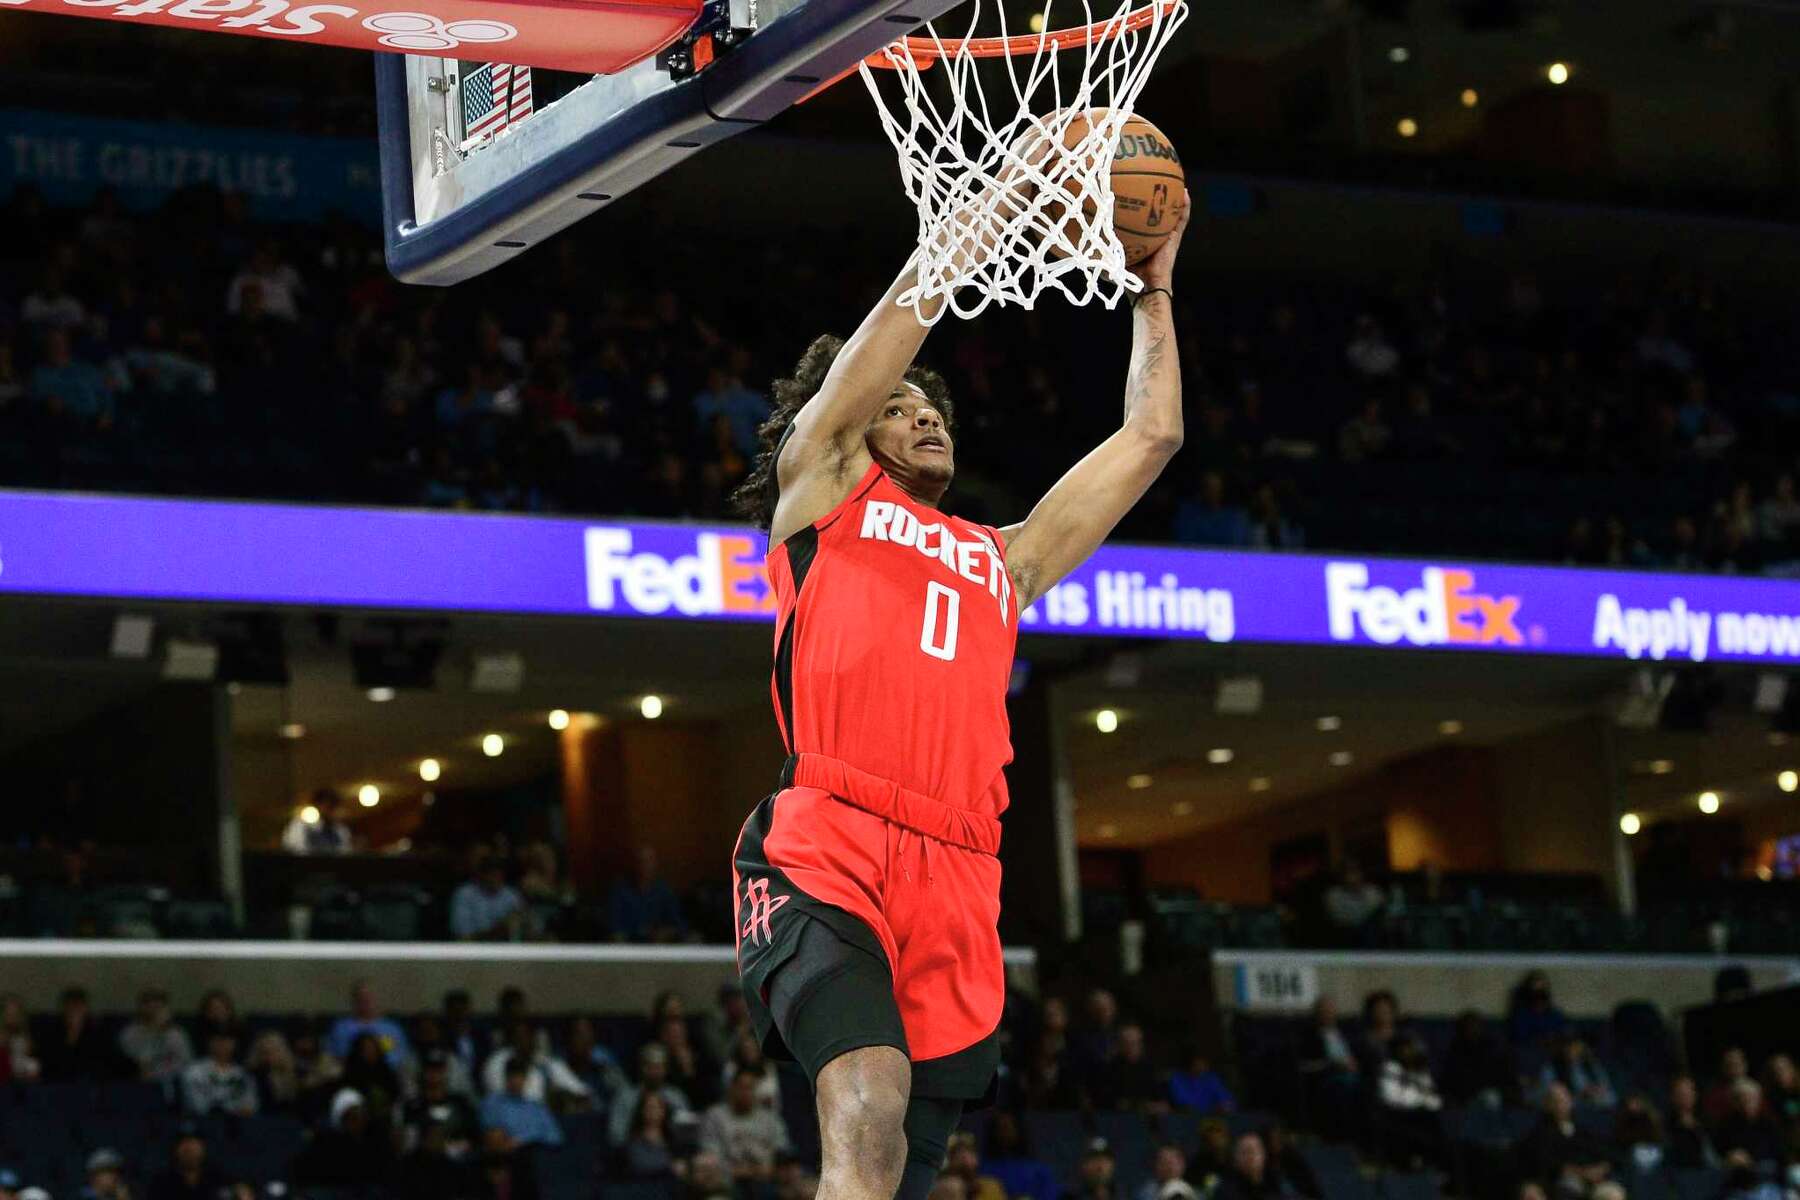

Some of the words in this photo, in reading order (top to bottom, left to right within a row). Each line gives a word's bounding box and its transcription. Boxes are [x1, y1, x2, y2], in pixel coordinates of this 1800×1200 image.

[7, 134, 87, 182] THE
[919, 579, 961, 662] 0
[1095, 570, 1236, 643] Hiring
[1325, 561, 1524, 646] FedEx
[1593, 593, 1711, 662] Apply
